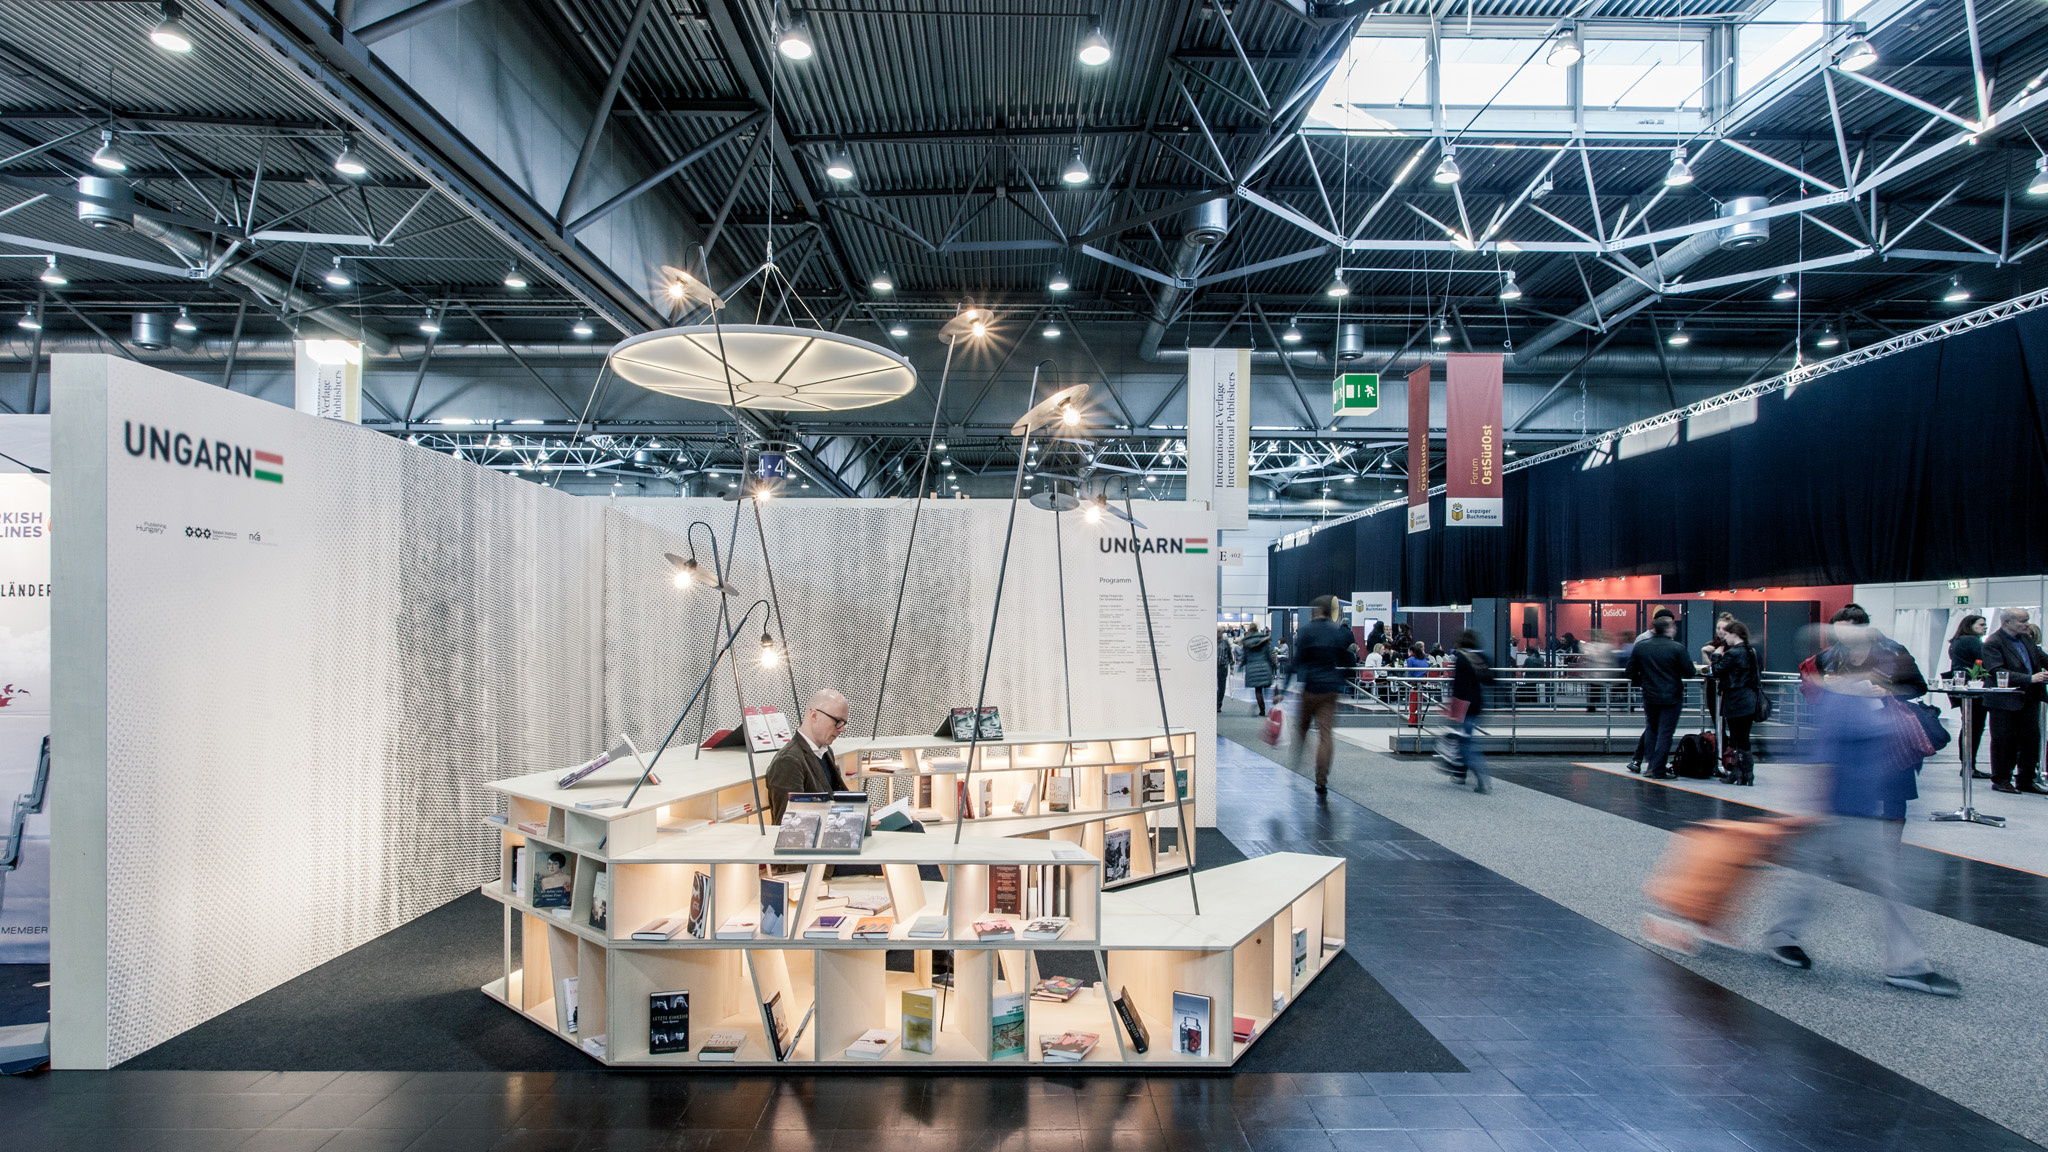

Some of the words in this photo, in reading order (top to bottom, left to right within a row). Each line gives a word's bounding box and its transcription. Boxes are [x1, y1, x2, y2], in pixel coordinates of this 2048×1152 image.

[322, 380, 332, 414] Verlage
[333, 370, 342, 418] Publishers
[1216, 382, 1226, 418] Verlage
[1227, 372, 1236, 423] Publishers
[124, 420, 252, 479] UNGARN
[1215, 420, 1223, 488] Internationale
[1226, 425, 1235, 488] International
[1481, 424, 1492, 485] OstSüdOst
[1470, 458, 1478, 485] Forum
[0, 512, 43, 524] KISH
[136, 525, 164, 535] Hungary
[1099, 537, 1183, 554] UNGARN
[1219, 551, 1227, 561] E
[1049, 783, 1062, 791] Die
[1, 926, 49, 935] MEMBER
